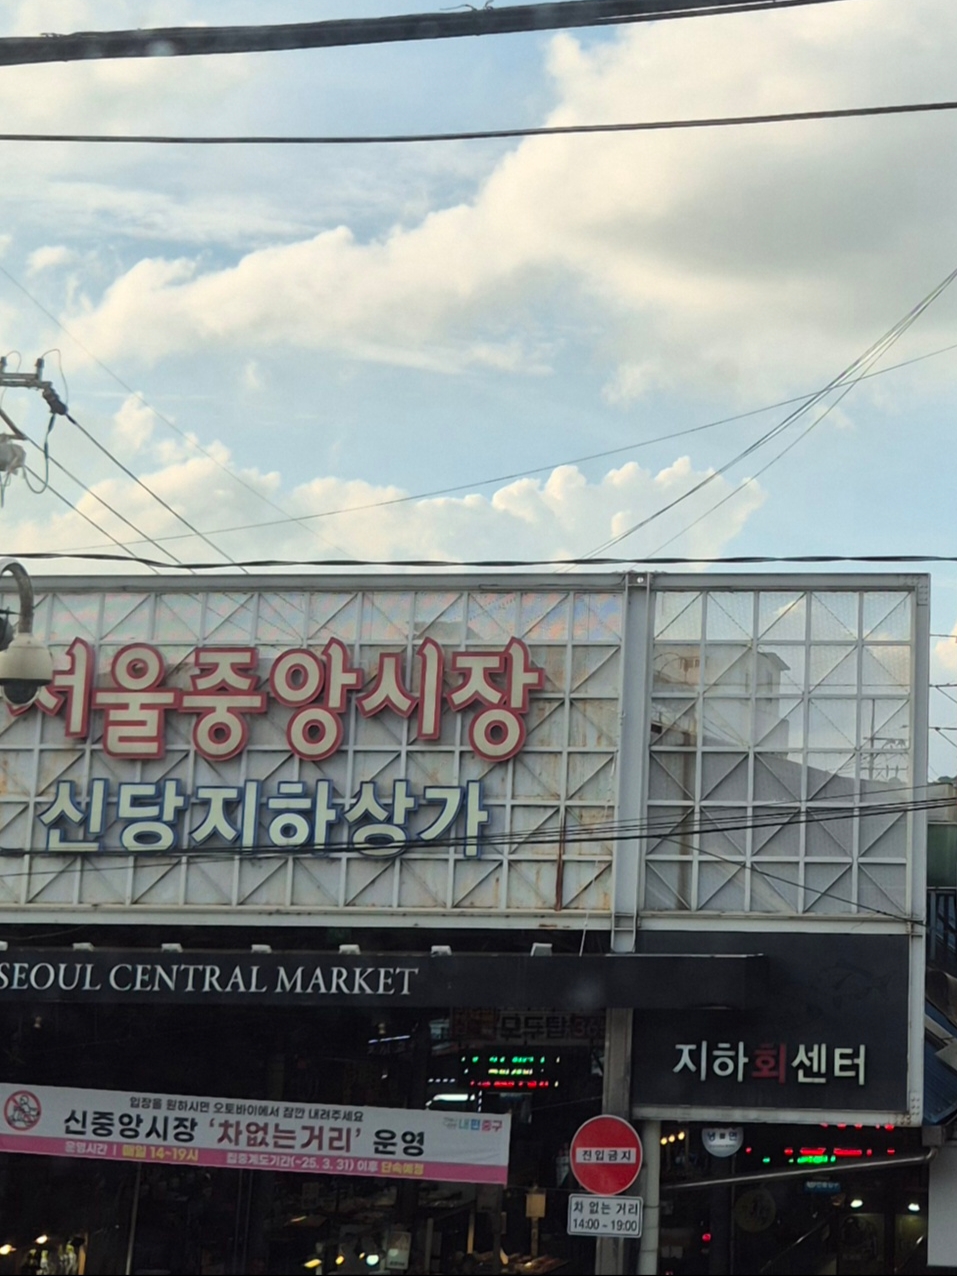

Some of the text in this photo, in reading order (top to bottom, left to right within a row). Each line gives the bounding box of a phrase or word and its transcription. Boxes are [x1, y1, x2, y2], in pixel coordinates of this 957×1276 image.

[8, 636, 545, 761] 서울중앙시장
[37, 777, 491, 859] 신당지하상가
[0, 962, 420, 996] SEOUL CENTRAL MARKET
[672, 1040, 866, 1085] 지하회센터
[129, 1096, 163, 1110] 입장을
[213, 1102, 280, 1118] 오토바이에서
[308, 1107, 365, 1123] 내려주세요
[63, 1109, 199, 1143] 신중앙시장
[373, 1128, 425, 1157] 운영
[582, 1149, 631, 1162] 진입금지
[572, 1201, 638, 1216] 차 없는 거리
[573, 1218, 600, 1231] 14:00
[611, 1220, 638, 1232] 19:00
